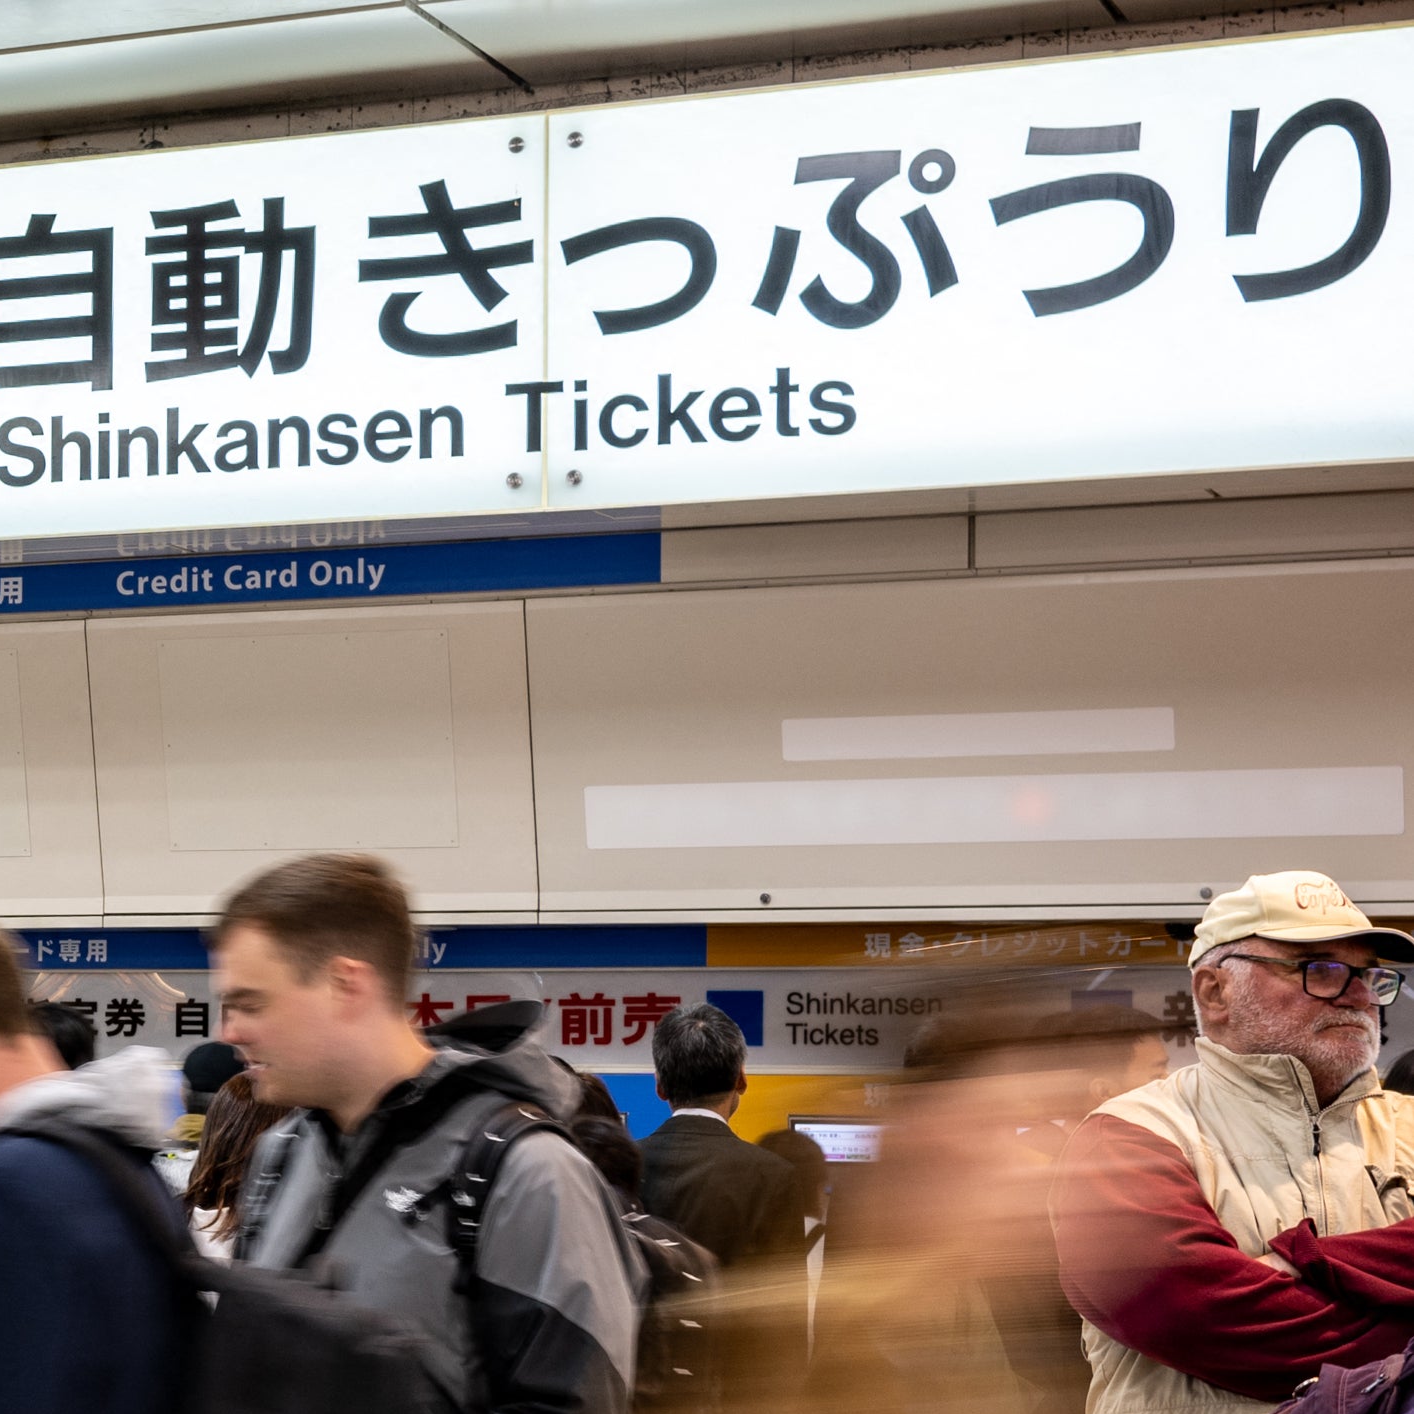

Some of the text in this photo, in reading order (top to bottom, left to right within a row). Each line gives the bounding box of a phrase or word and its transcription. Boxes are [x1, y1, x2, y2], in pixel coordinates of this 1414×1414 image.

[505, 367, 857, 453] Tickets
[116, 558, 386, 596] Credit Card Only
[785, 991, 943, 1016] Shinkansen
[785, 1022, 879, 1047] Tickets
